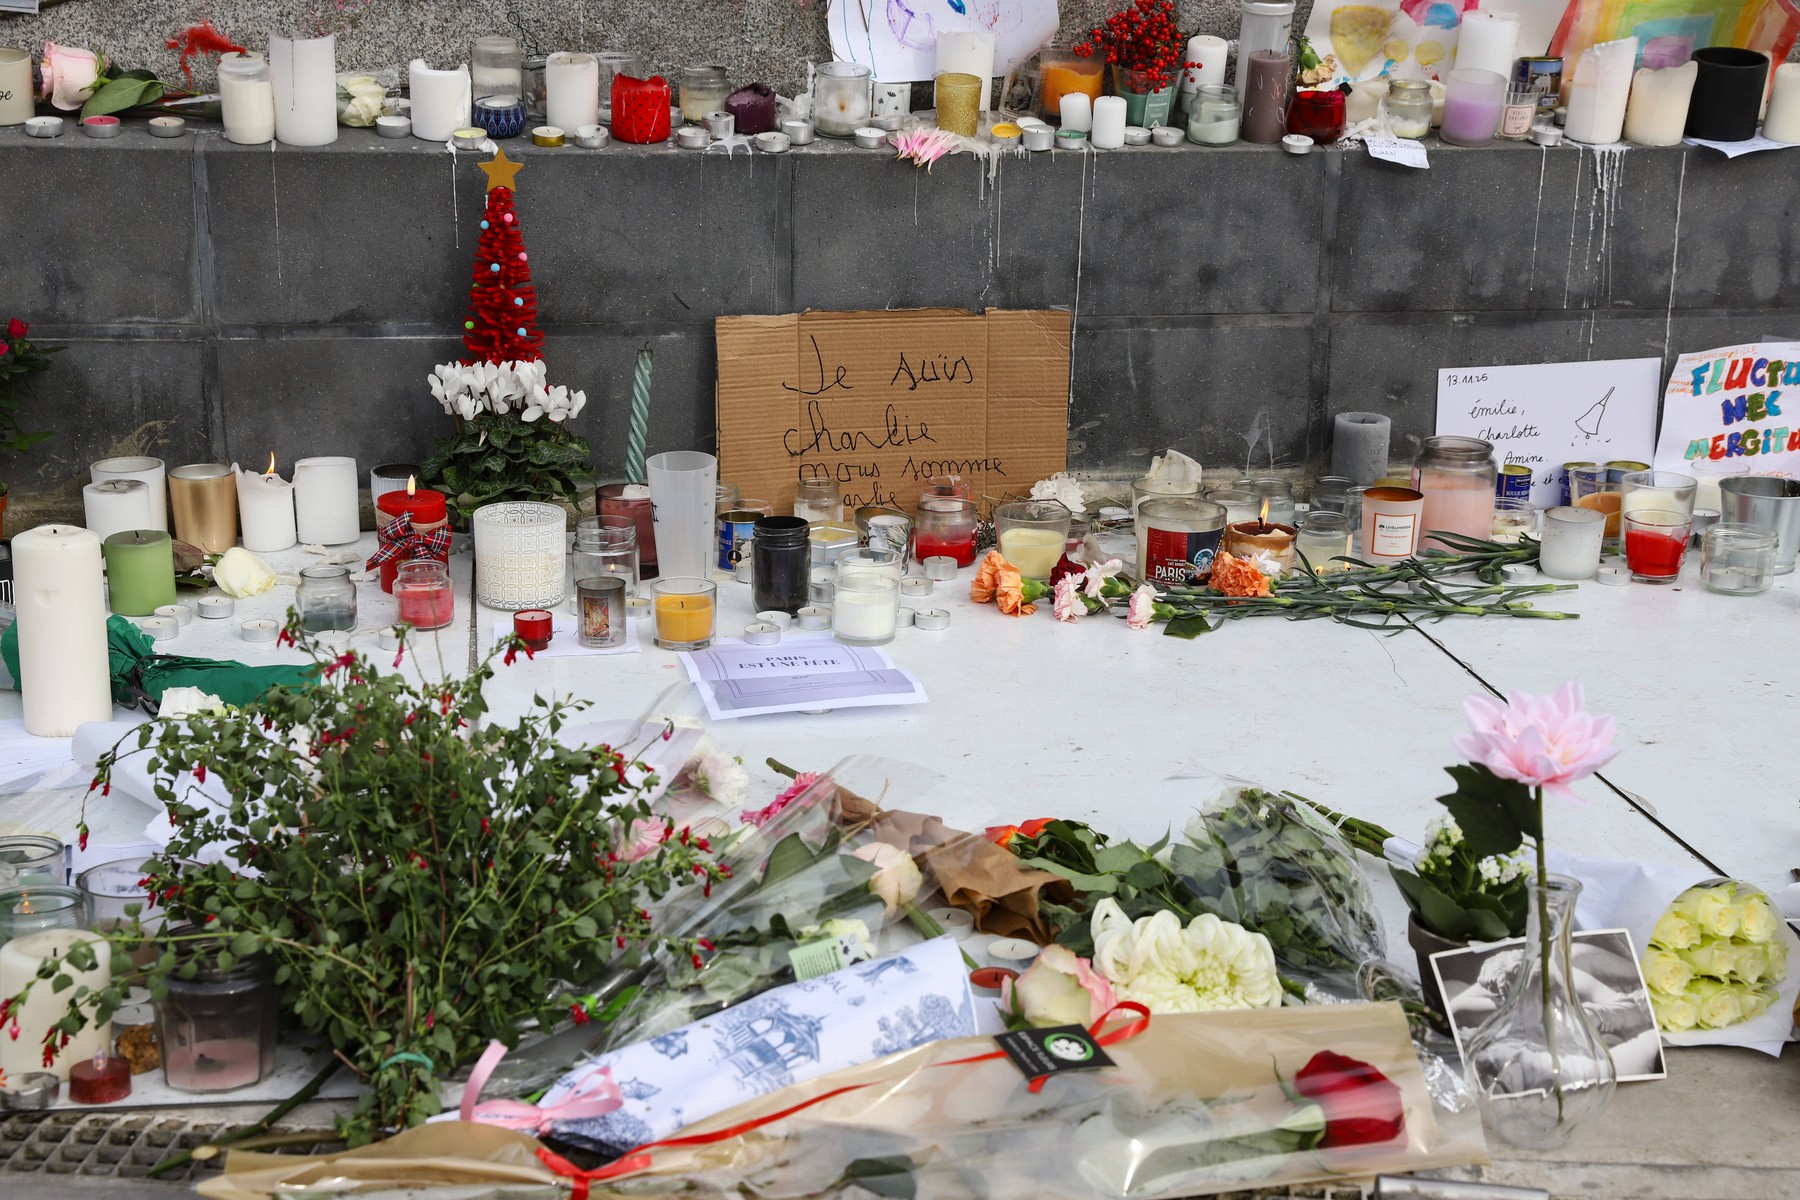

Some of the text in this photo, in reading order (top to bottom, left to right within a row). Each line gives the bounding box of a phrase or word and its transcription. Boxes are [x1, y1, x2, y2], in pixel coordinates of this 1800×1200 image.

[782, 334, 853, 395] Je
[1446, 373, 1488, 387] 13.11.25
[1721, 390, 1782, 425] NEC
[1155, 565, 1186, 582] PARIS
[771, 660, 800, 668] UNE
